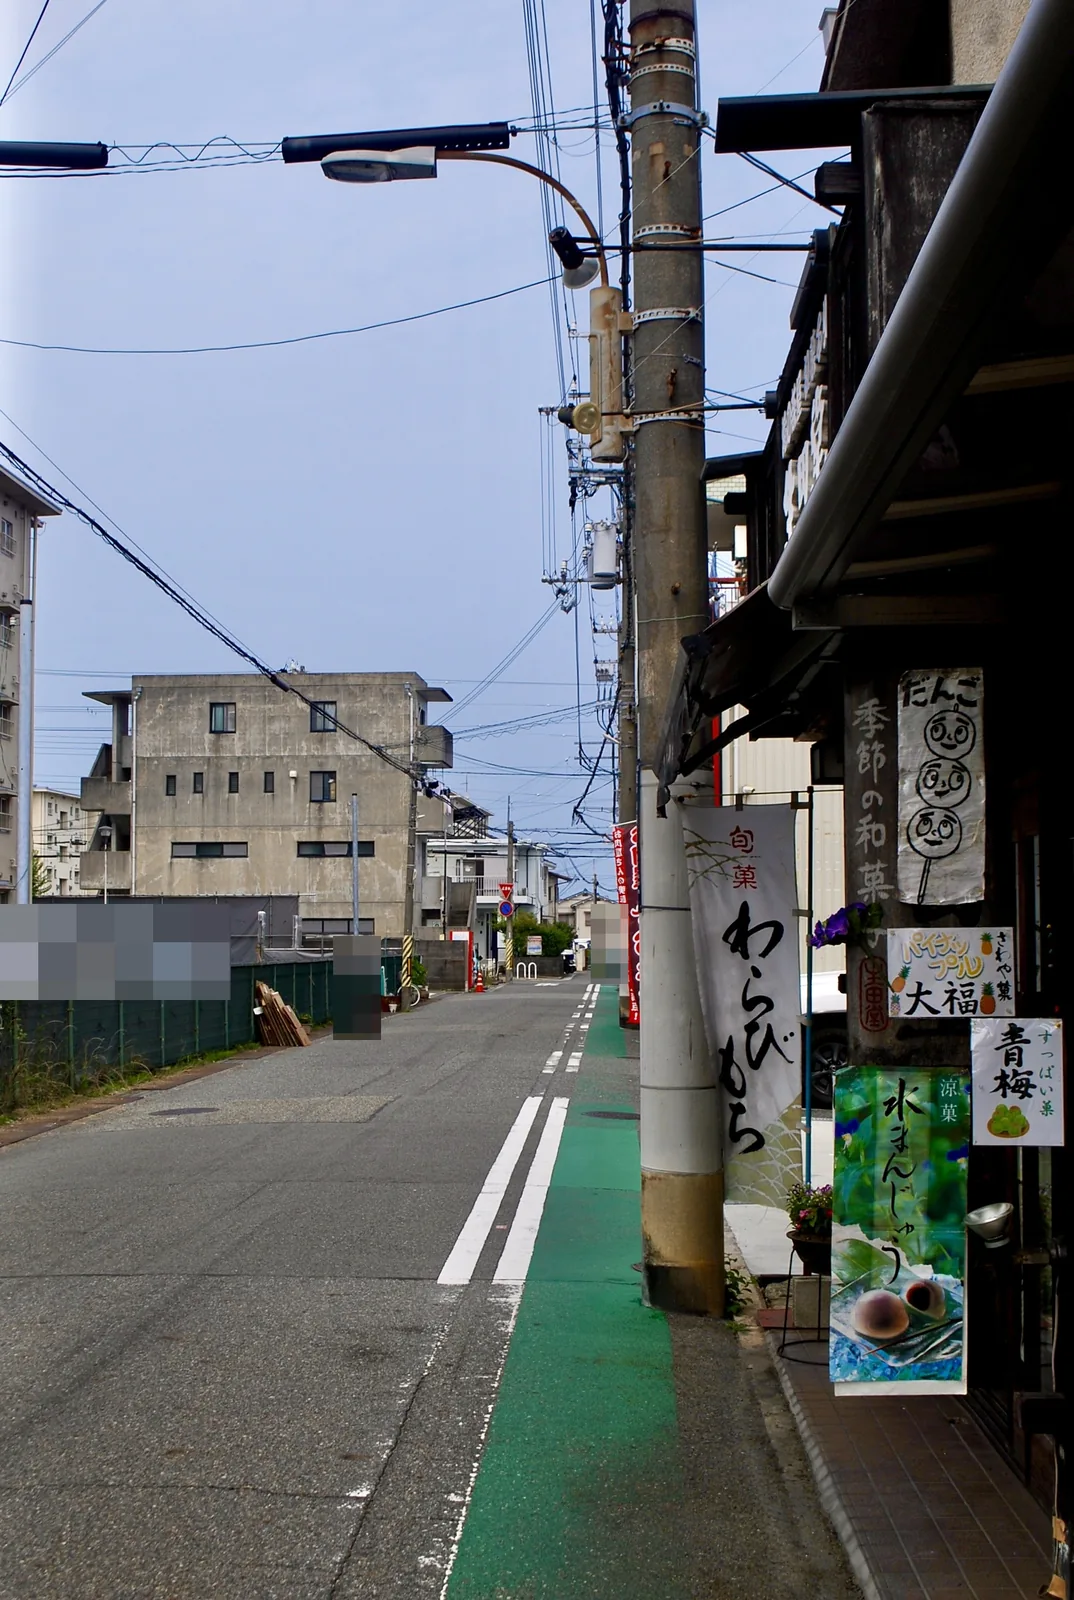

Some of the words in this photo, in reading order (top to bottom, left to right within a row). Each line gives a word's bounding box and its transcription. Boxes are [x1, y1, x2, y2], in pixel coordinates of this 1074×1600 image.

[902, 676, 981, 708] だんご
[729, 825, 758, 890] 旬菓
[903, 931, 969, 964] パイナッ
[928, 954, 985, 981] プル
[995, 931, 1013, 1002] さわや菓
[904, 980, 980, 1016] 大福
[718, 900, 796, 1155] わらびもち
[989, 1023, 1038, 1100] 青梅
[939, 1078, 958, 1123] 涼菓
[882, 1077, 927, 1286] 水まんじゅう
